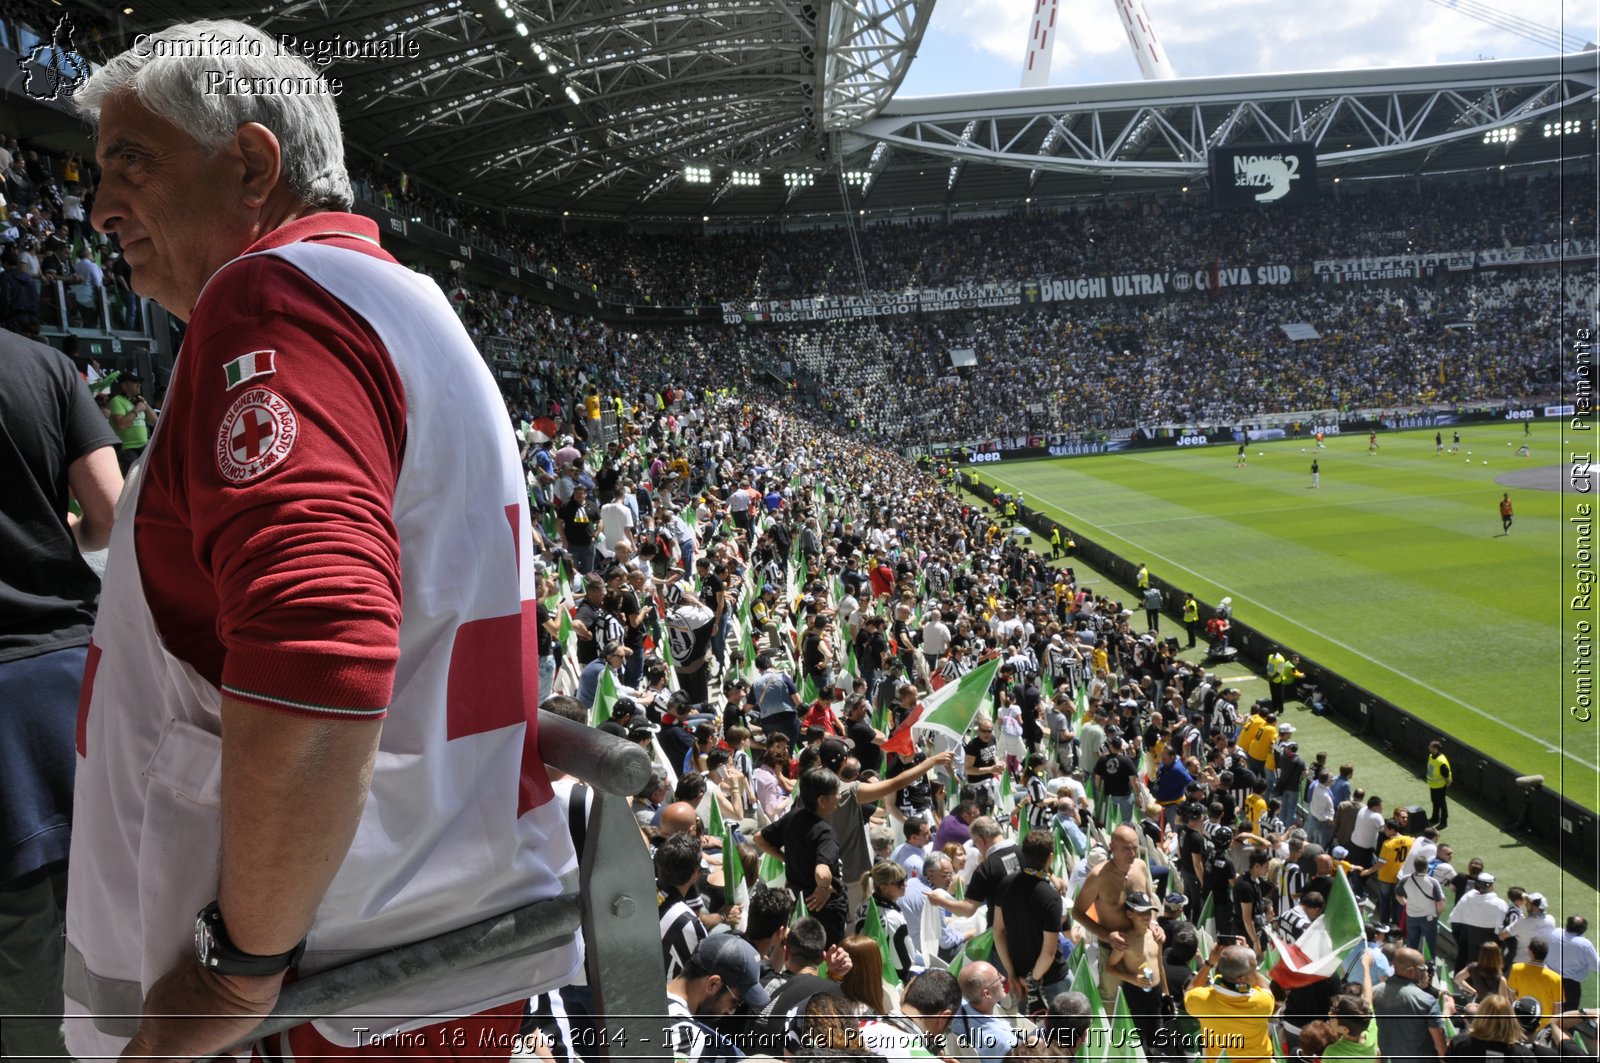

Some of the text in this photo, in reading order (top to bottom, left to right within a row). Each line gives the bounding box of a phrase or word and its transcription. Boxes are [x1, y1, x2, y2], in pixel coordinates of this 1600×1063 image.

[1345, 268, 1411, 282] FALCHERA
[1040, 277, 1107, 302] DRUGHI
[1112, 273, 1169, 297] ULTRA'
[1257, 265, 1292, 285] SUD
[936, 287, 1005, 302] MAGENTA
[852, 304, 910, 317] BELGIO
[723, 314, 742, 325] SUD
[233, 391, 272, 413] GINEVRA
[271, 400, 281, 412] 22
[227, 410, 236, 423] DI
[1505, 409, 1535, 420] Jeep
[276, 411, 294, 454] AGOSTO
[1310, 425, 1339, 436] Jeep
[1176, 435, 1207, 446] Jeep
[218, 423, 246, 479] CONVENZIONE
[969, 452, 1001, 463] Jeep
